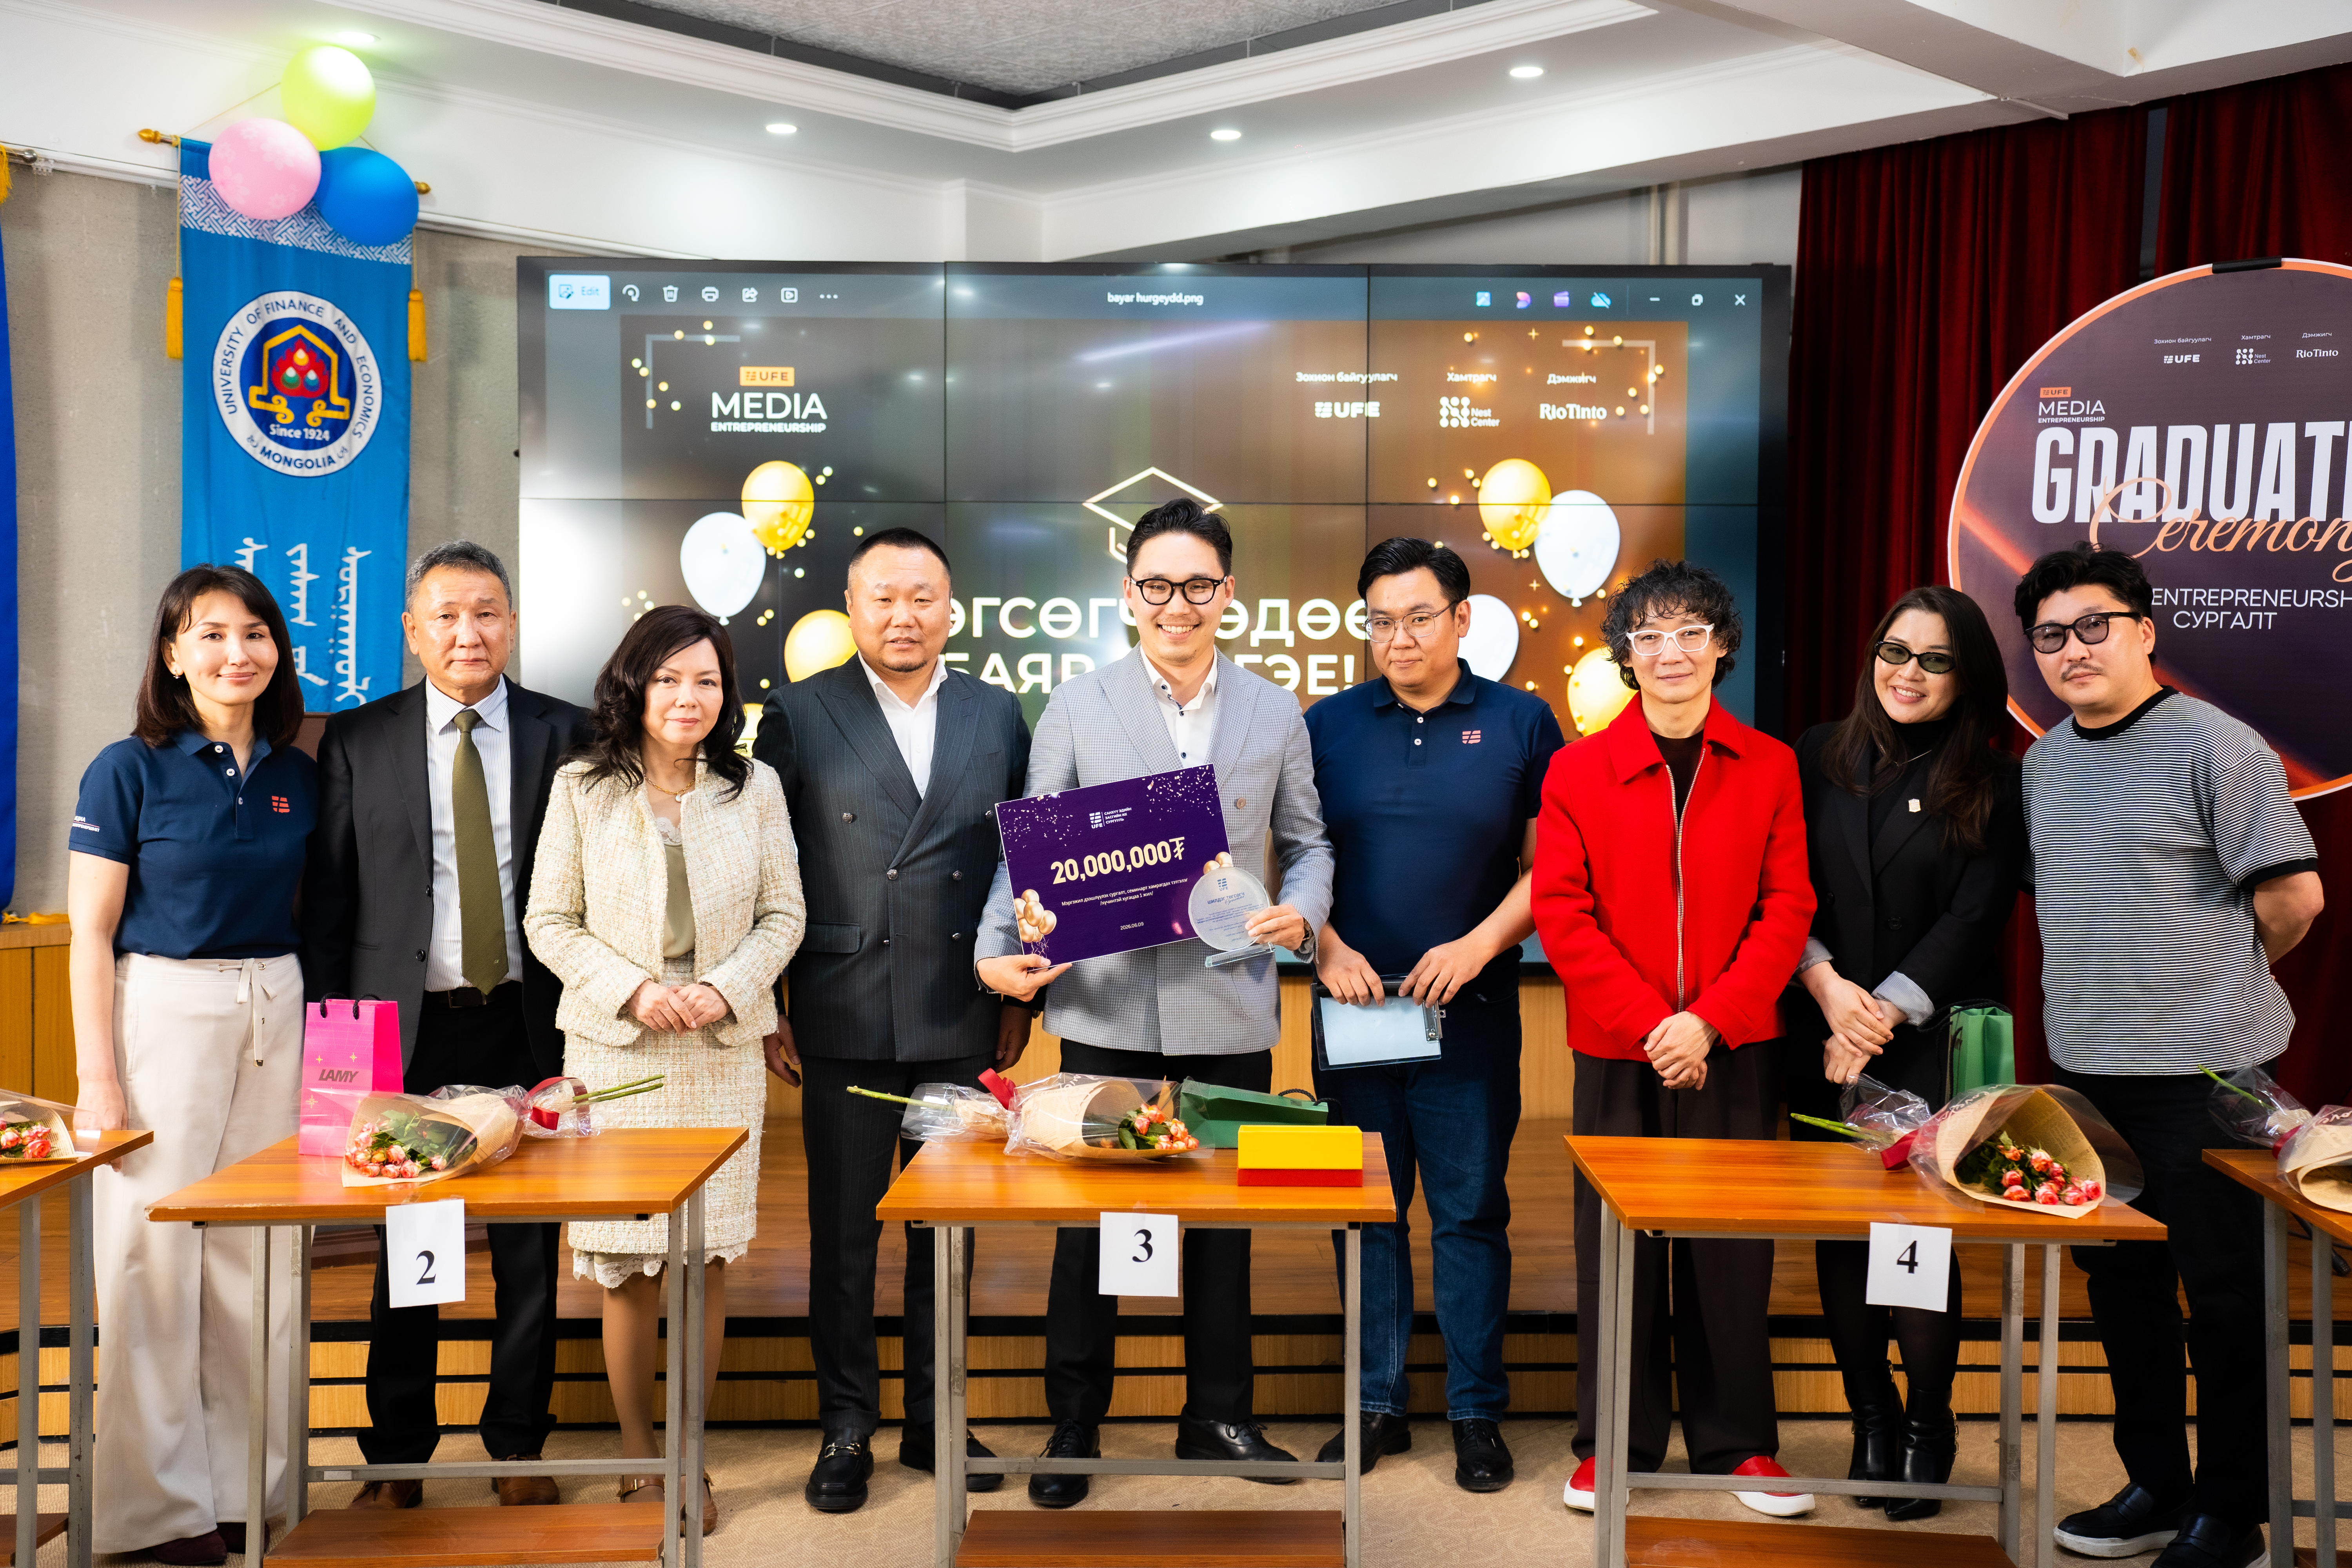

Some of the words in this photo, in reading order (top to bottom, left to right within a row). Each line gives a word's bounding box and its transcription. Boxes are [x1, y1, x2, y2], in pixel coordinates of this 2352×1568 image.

[581, 286, 599, 297] Edit
[1107, 292, 1135, 305] bayar
[1136, 292, 1204, 305] hurgeydd.png
[2174, 354, 2200, 364] UFE
[220, 327, 244, 414] UNIVERSITY
[247, 308, 261, 324] OF
[265, 299, 324, 318] FINANCE
[334, 318, 356, 345] AND
[355, 355, 375, 439] ECONOMICS
[760, 372, 788, 381] UFE
[1296, 372, 1335, 383] Зохион
[1336, 371, 1398, 384] байгуулагч
[1447, 372, 1497, 383] Хамтрагч
[1546, 373, 1596, 385] Дэмжигч
[712, 392, 828, 419] MEDIA
[1334, 401, 1380, 418] UFE
[1471, 408, 1492, 417] Nest
[2039, 400, 2105, 416] MEDIA
[711, 421, 826, 433] ENTREPRENEURSHIP
[1470, 417, 1500, 427] Center
[269, 424, 301, 439] Since
[303, 428, 330, 441] 1924
[260, 446, 336, 469] MONGOLIA
[2090, 475, 2352, 583] Ceremon
[2173, 611, 2278, 629] СУРГАЛТ
[1084, 893, 1109, 902] дээшлүүлэх
[1148, 881, 1171, 889] хамрагдах
[1120, 922, 1144, 930] 2026.06.09
[318, 1069, 358, 1083] LAMY
[1132, 1229, 1153, 1262] 3
[1897, 1240, 1918, 1274] 4
[416, 1250, 436, 1285] 2
